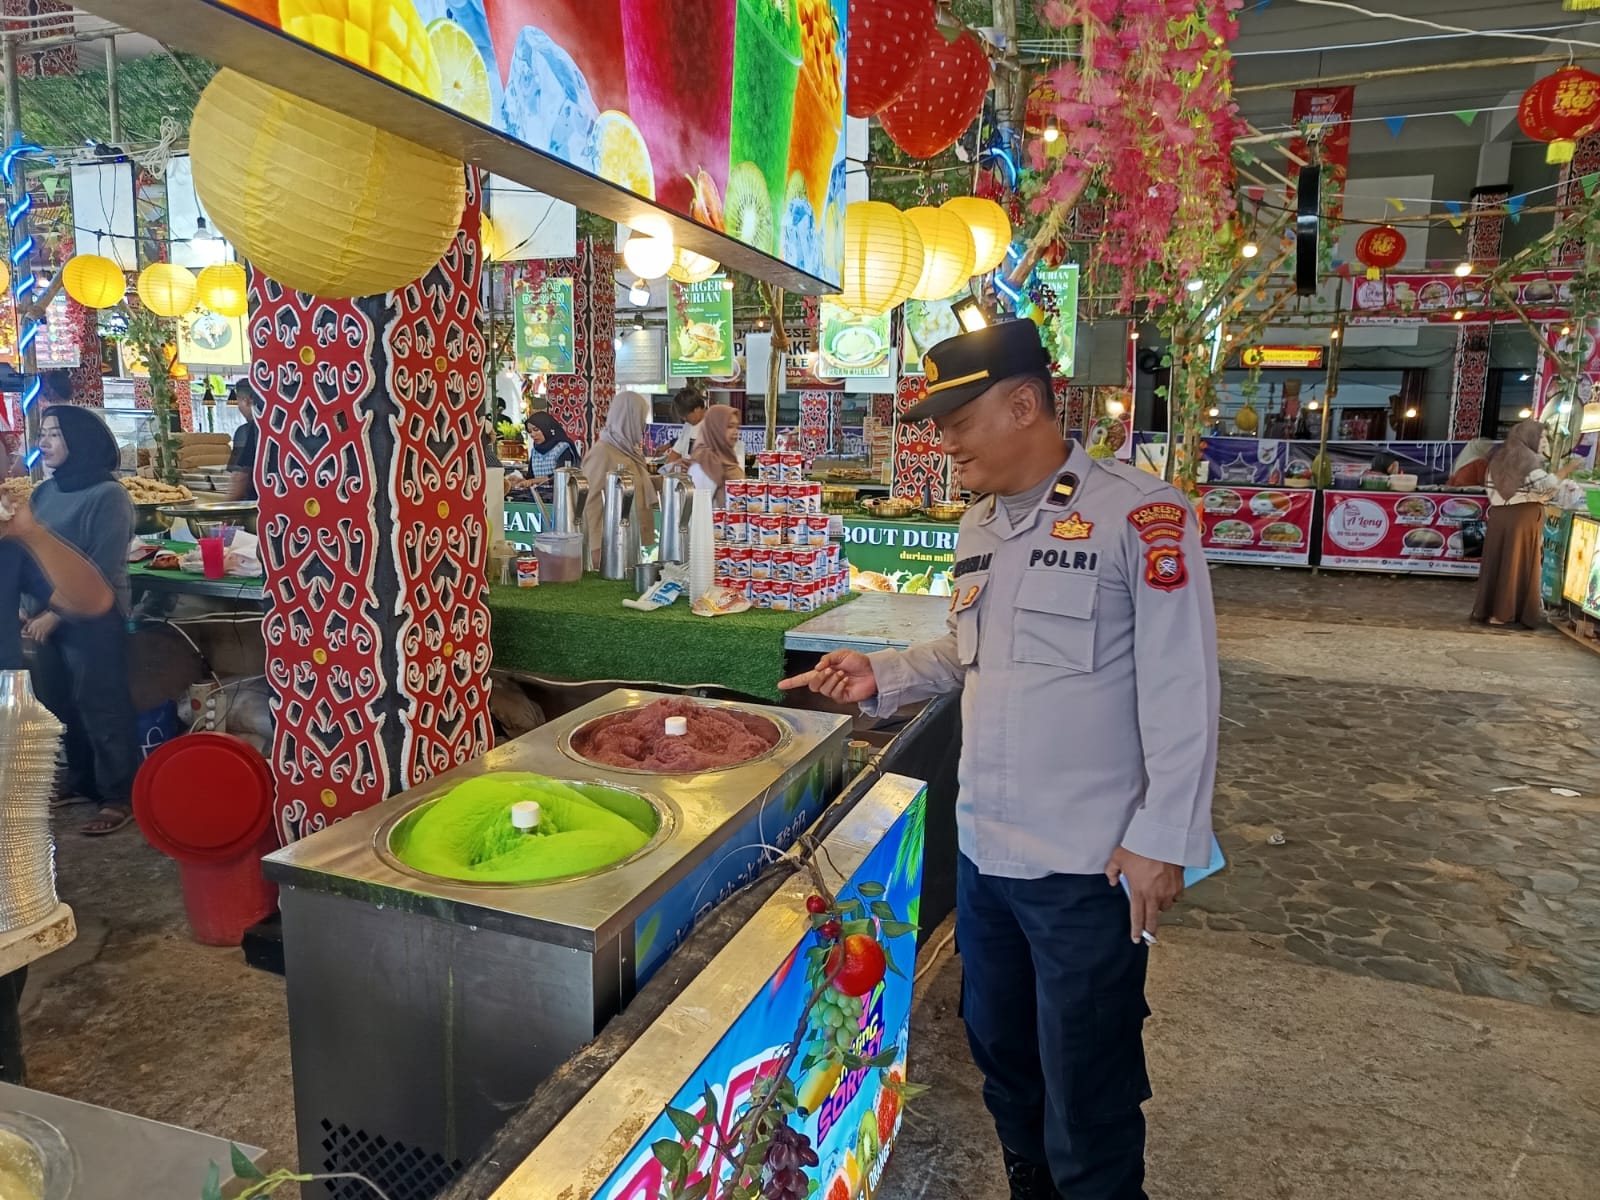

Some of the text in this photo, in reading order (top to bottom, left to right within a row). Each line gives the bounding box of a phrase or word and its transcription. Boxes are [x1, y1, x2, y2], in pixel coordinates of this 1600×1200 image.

[843, 526, 899, 546] BOUT
[900, 551, 933, 562] durian
[1029, 549, 1098, 571] POLRI
